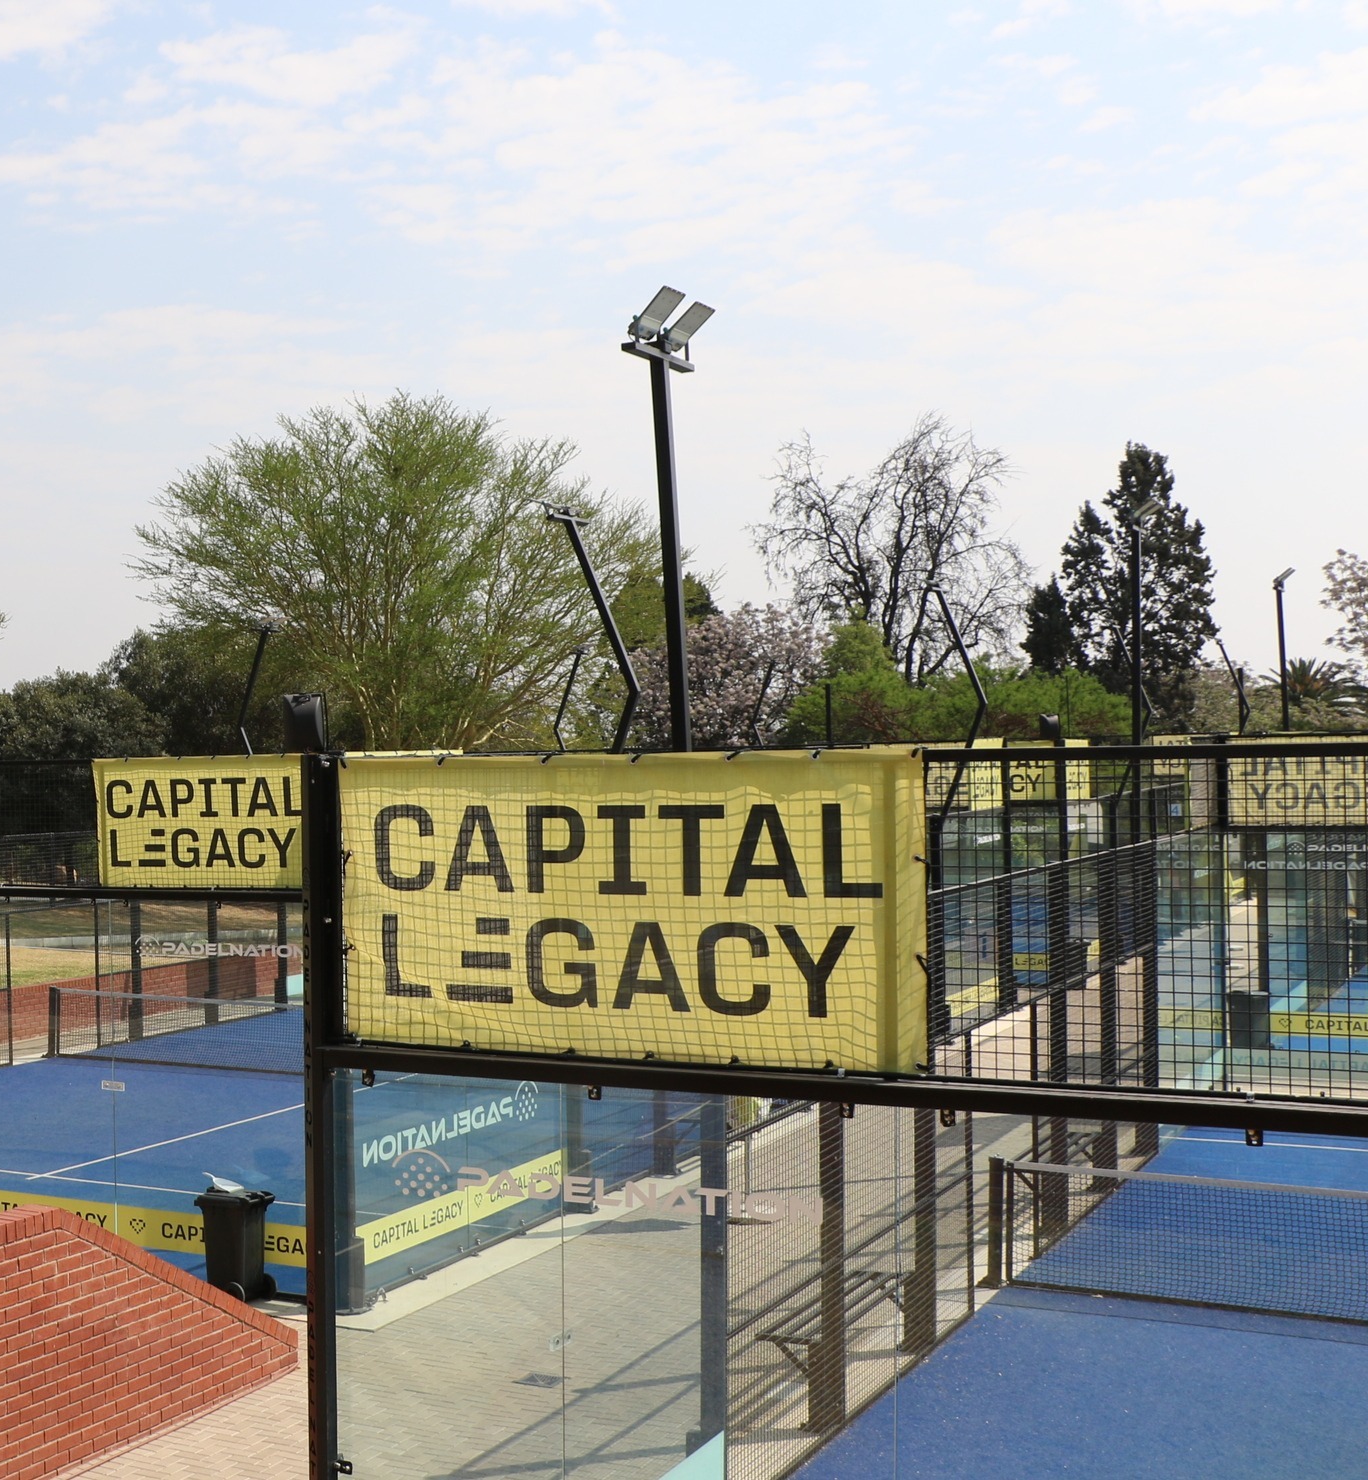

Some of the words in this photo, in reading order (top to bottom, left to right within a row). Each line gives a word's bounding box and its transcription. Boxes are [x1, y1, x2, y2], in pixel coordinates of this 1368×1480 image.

[106, 777, 302, 818] CAPITAL
[110, 828, 296, 868] LEGACY
[373, 803, 884, 898] CAPITAL
[382, 913, 856, 1018] LEGACY
[457, 1166, 824, 1225] PADELNATION
[161, 1222, 205, 1243] CAPI
[264, 1235, 304, 1255] EGA
[373, 1218, 419, 1248] CAPITAL
[423, 1200, 463, 1229] LEGACY
